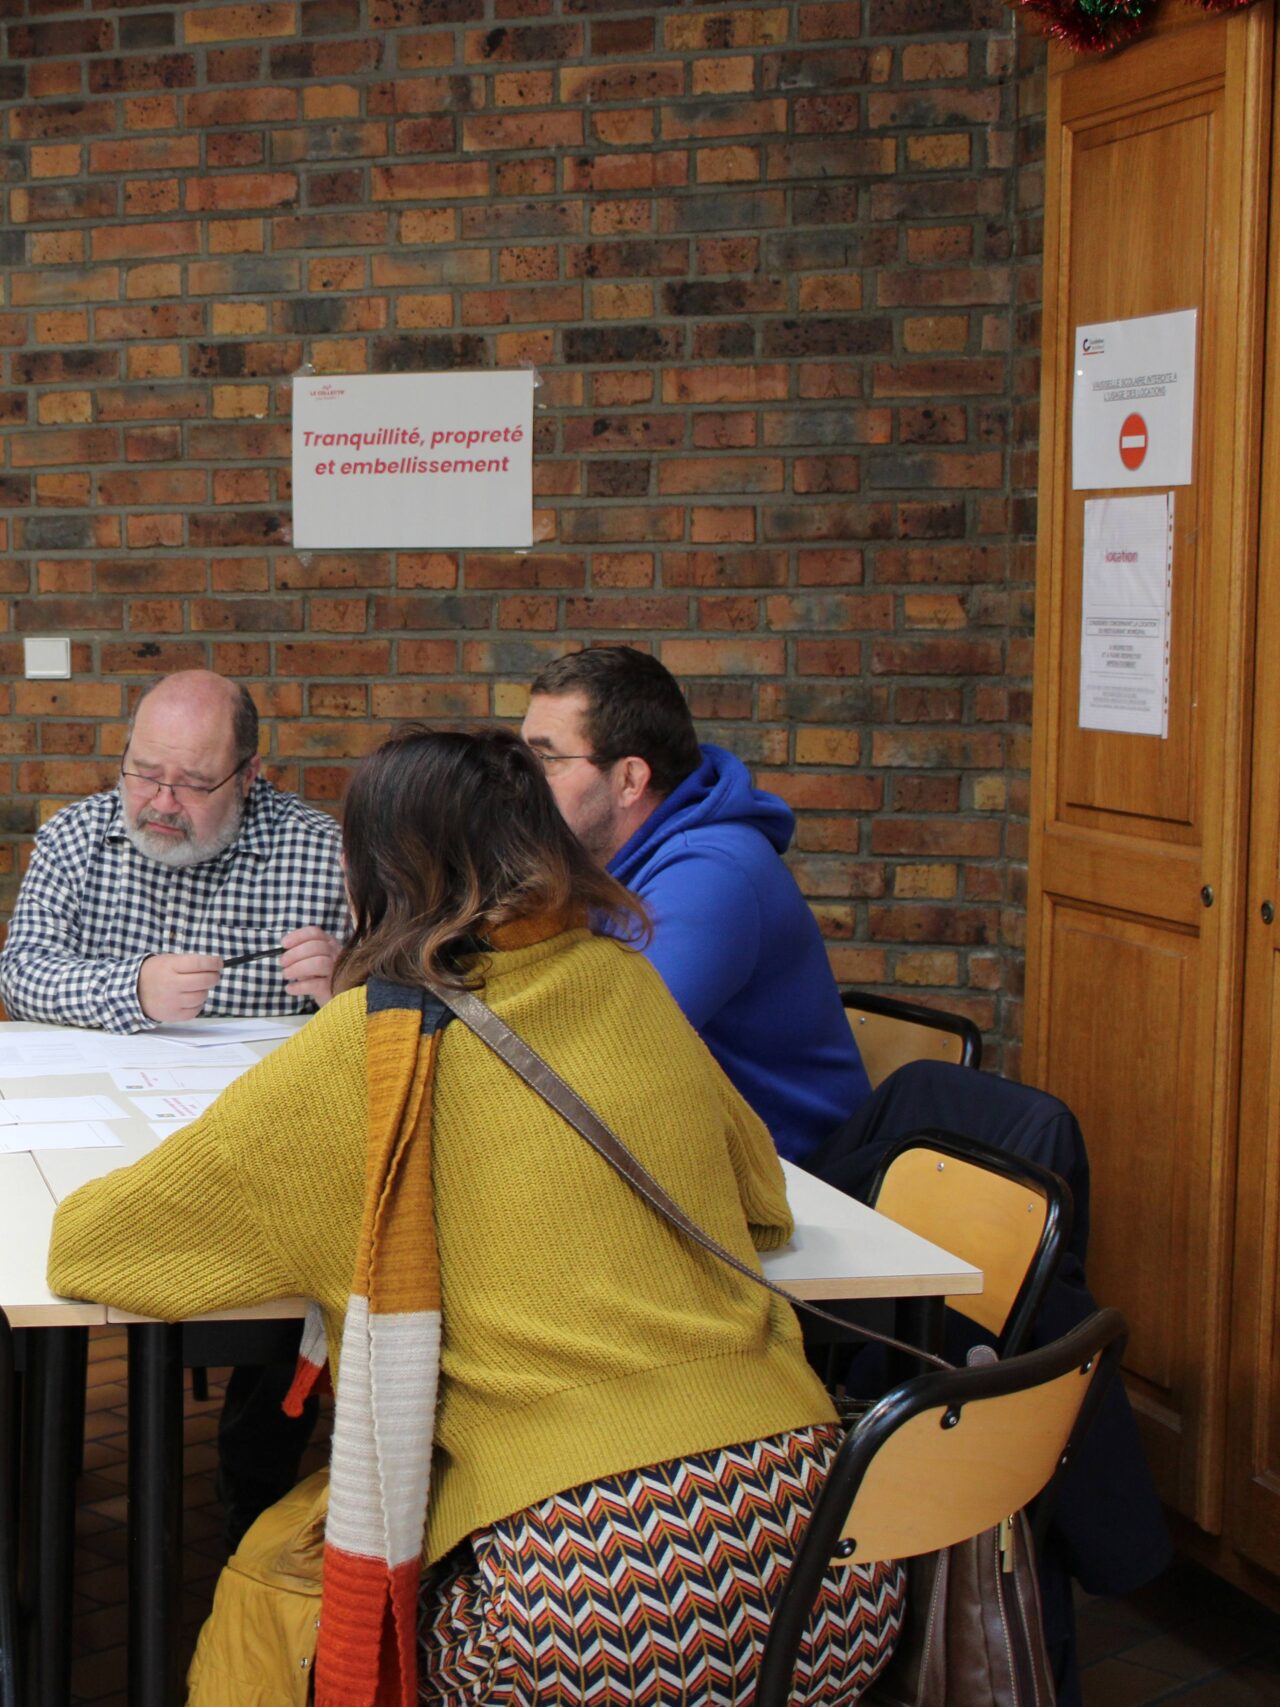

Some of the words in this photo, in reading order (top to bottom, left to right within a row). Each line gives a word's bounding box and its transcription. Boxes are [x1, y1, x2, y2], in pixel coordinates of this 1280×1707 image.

[303, 427, 424, 451] Tranquillité,
[430, 425, 523, 449] propreté
[315, 459, 335, 475] et
[340, 456, 510, 475] embellissement
